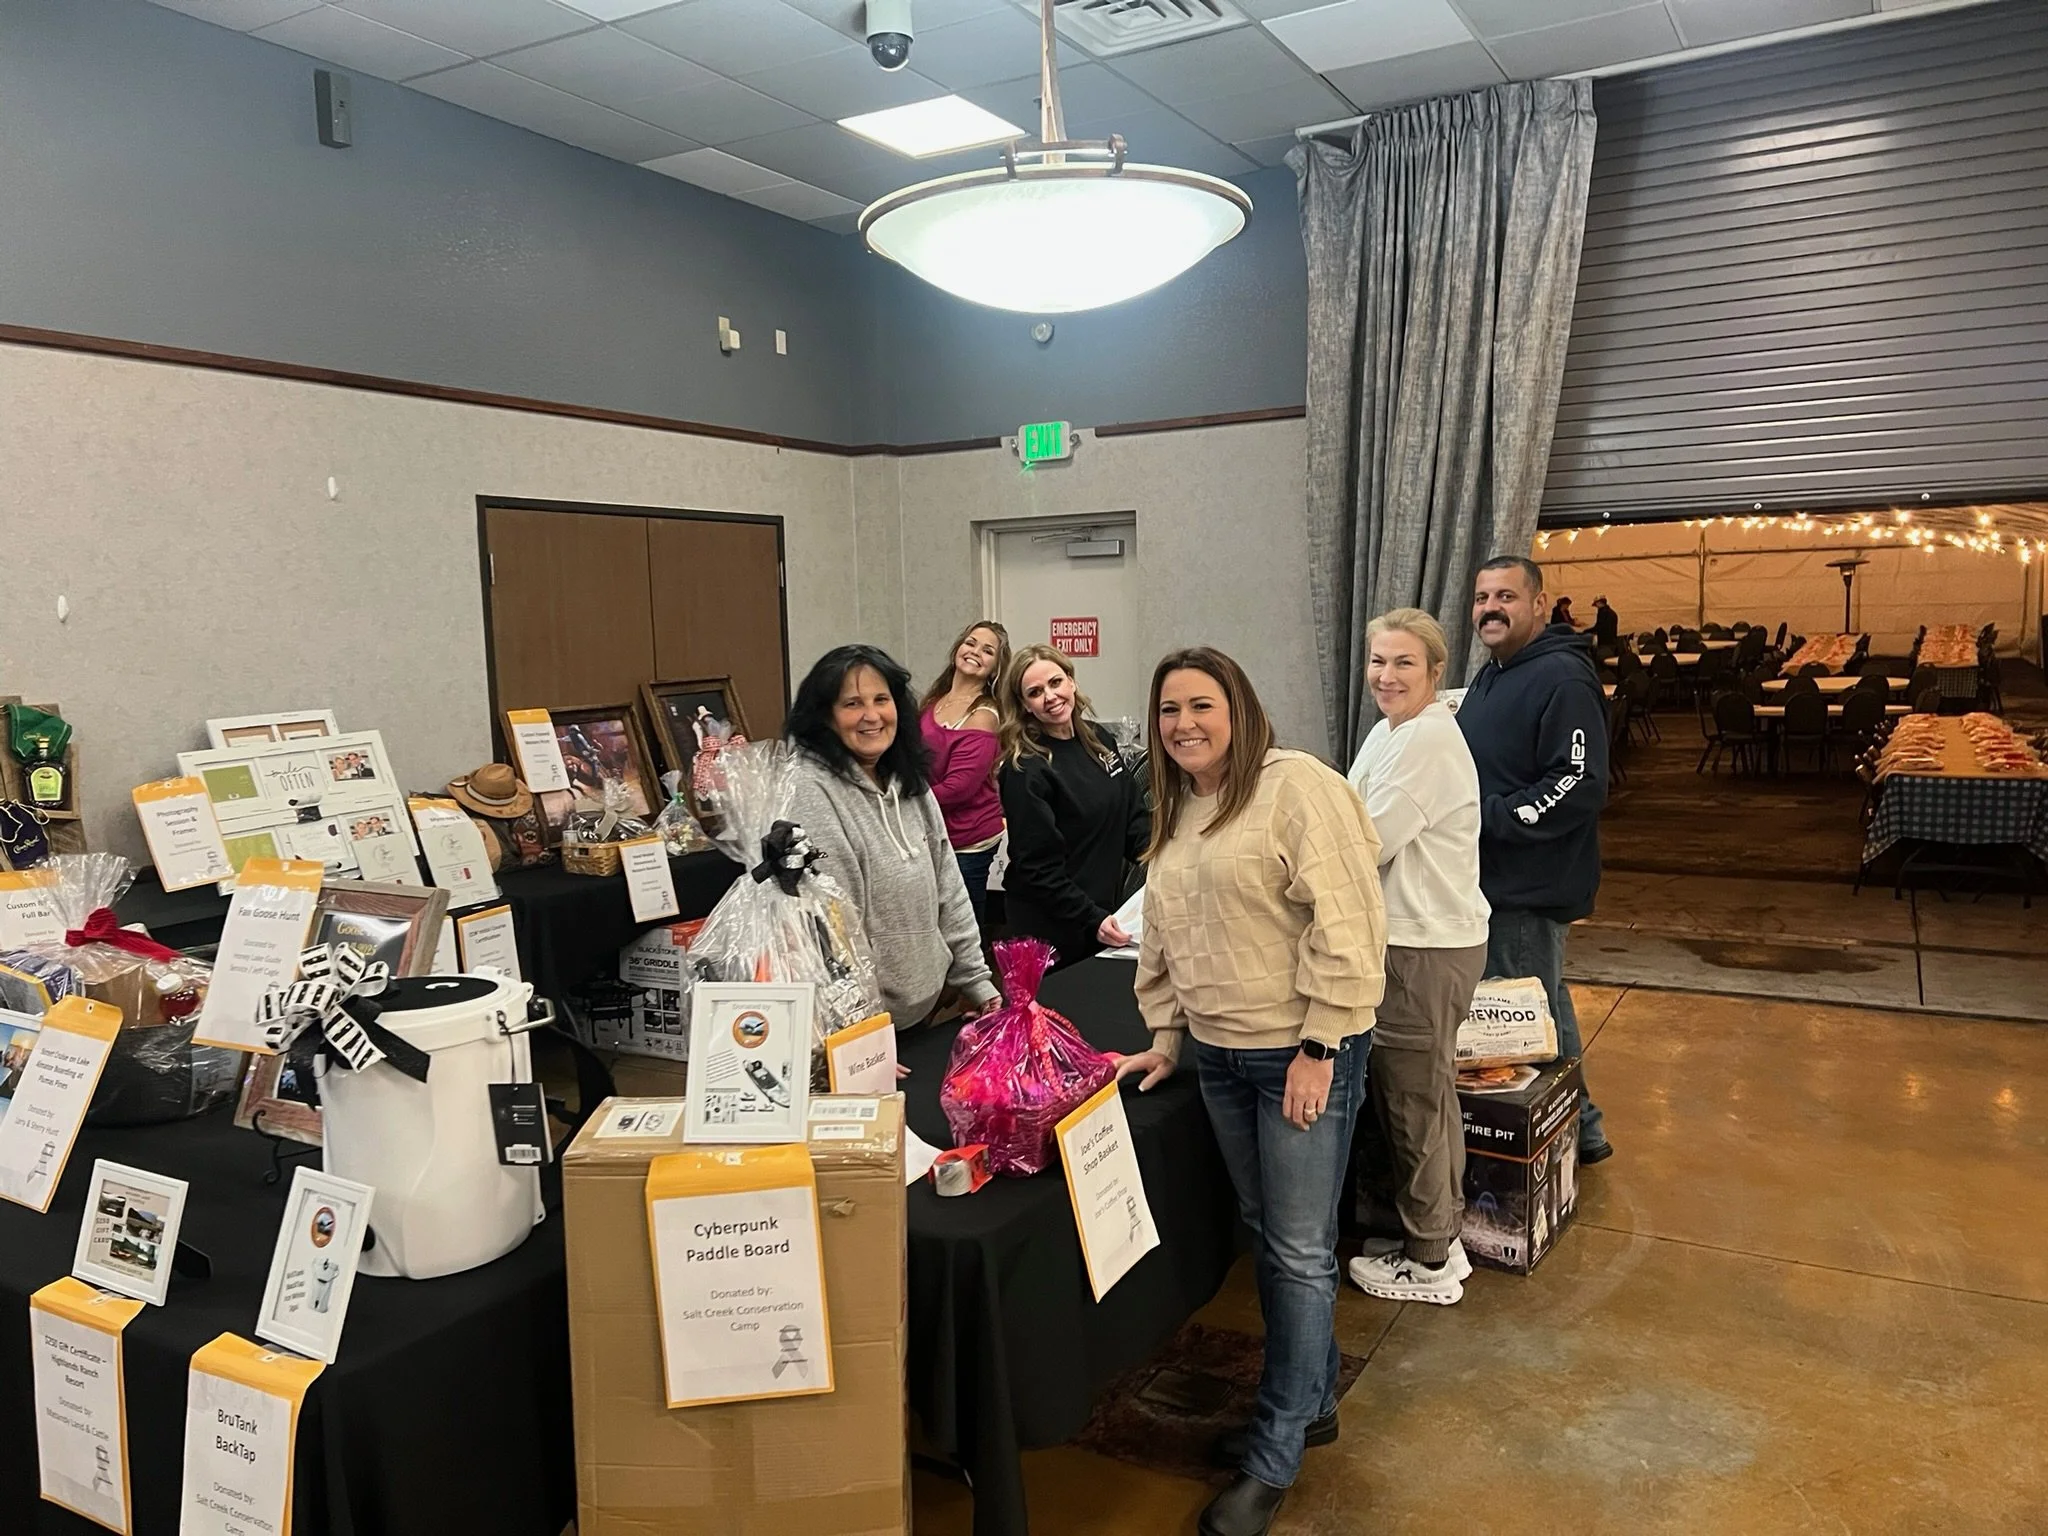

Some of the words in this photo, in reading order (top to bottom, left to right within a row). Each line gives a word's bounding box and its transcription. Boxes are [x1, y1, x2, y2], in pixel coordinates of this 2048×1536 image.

[1026, 422, 1063, 459] EXIT
[1052, 621, 1097, 637] EMERGENCY
[1056, 638, 1072, 653] EXIT
[1074, 638, 1093, 653] ONLY
[279, 772, 314, 792] OFTEN
[6, 902, 36, 910] Custom
[21, 911, 36, 919] Full
[253, 908, 278, 920] Goose
[278, 911, 300, 922] Hunt
[643, 958, 680, 969] GRIDDLE
[848, 1062, 866, 1077] Wine
[865, 1051, 887, 1069] Basket
[1094, 1123, 1114, 1144] Coffee
[1464, 1123, 1492, 1137] FIRE
[1495, 1129, 1515, 1141] PIT
[1083, 1157, 1099, 1176] Shop
[1098, 1140, 1119, 1162] Basket
[694, 1216, 779, 1240] Cyberpunk
[686, 1245, 740, 1262] Paddle
[744, 1239, 790, 1258] Board
[710, 1287, 755, 1300] Donated
[757, 1286, 773, 1298] by:
[683, 1309, 702, 1320] Salt
[704, 1306, 734, 1318] Creek
[736, 1301, 804, 1316] Conservation
[730, 1321, 761, 1332] Camp
[217, 1408, 258, 1436] BruTank
[215, 1435, 256, 1465] BackTap
[213, 1481, 243, 1501] Donated
[209, 1499, 229, 1515] Creek
[229, 1507, 274, 1533] Conservation
